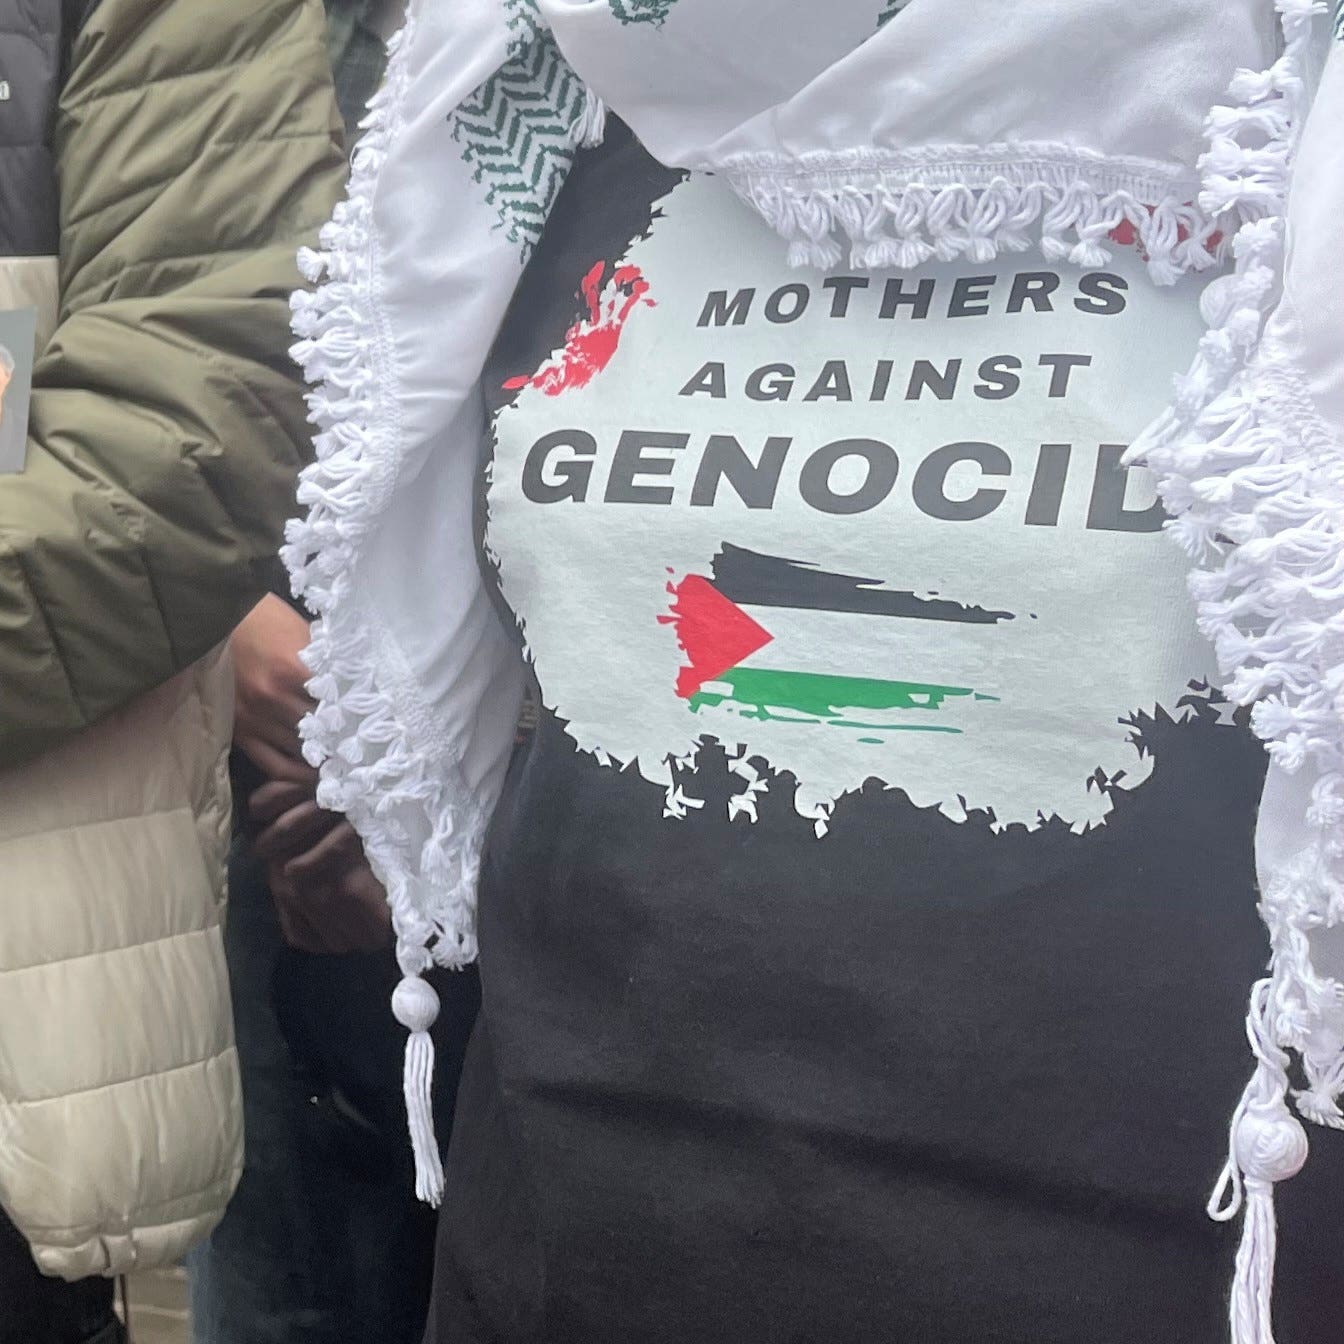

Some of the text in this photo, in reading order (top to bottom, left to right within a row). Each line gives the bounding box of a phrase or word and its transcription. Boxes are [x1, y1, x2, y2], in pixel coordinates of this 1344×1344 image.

[696, 271, 1129, 328] MOTHERS
[678, 353, 1092, 402] AGAINST
[521, 429, 1180, 533] GENOCID
